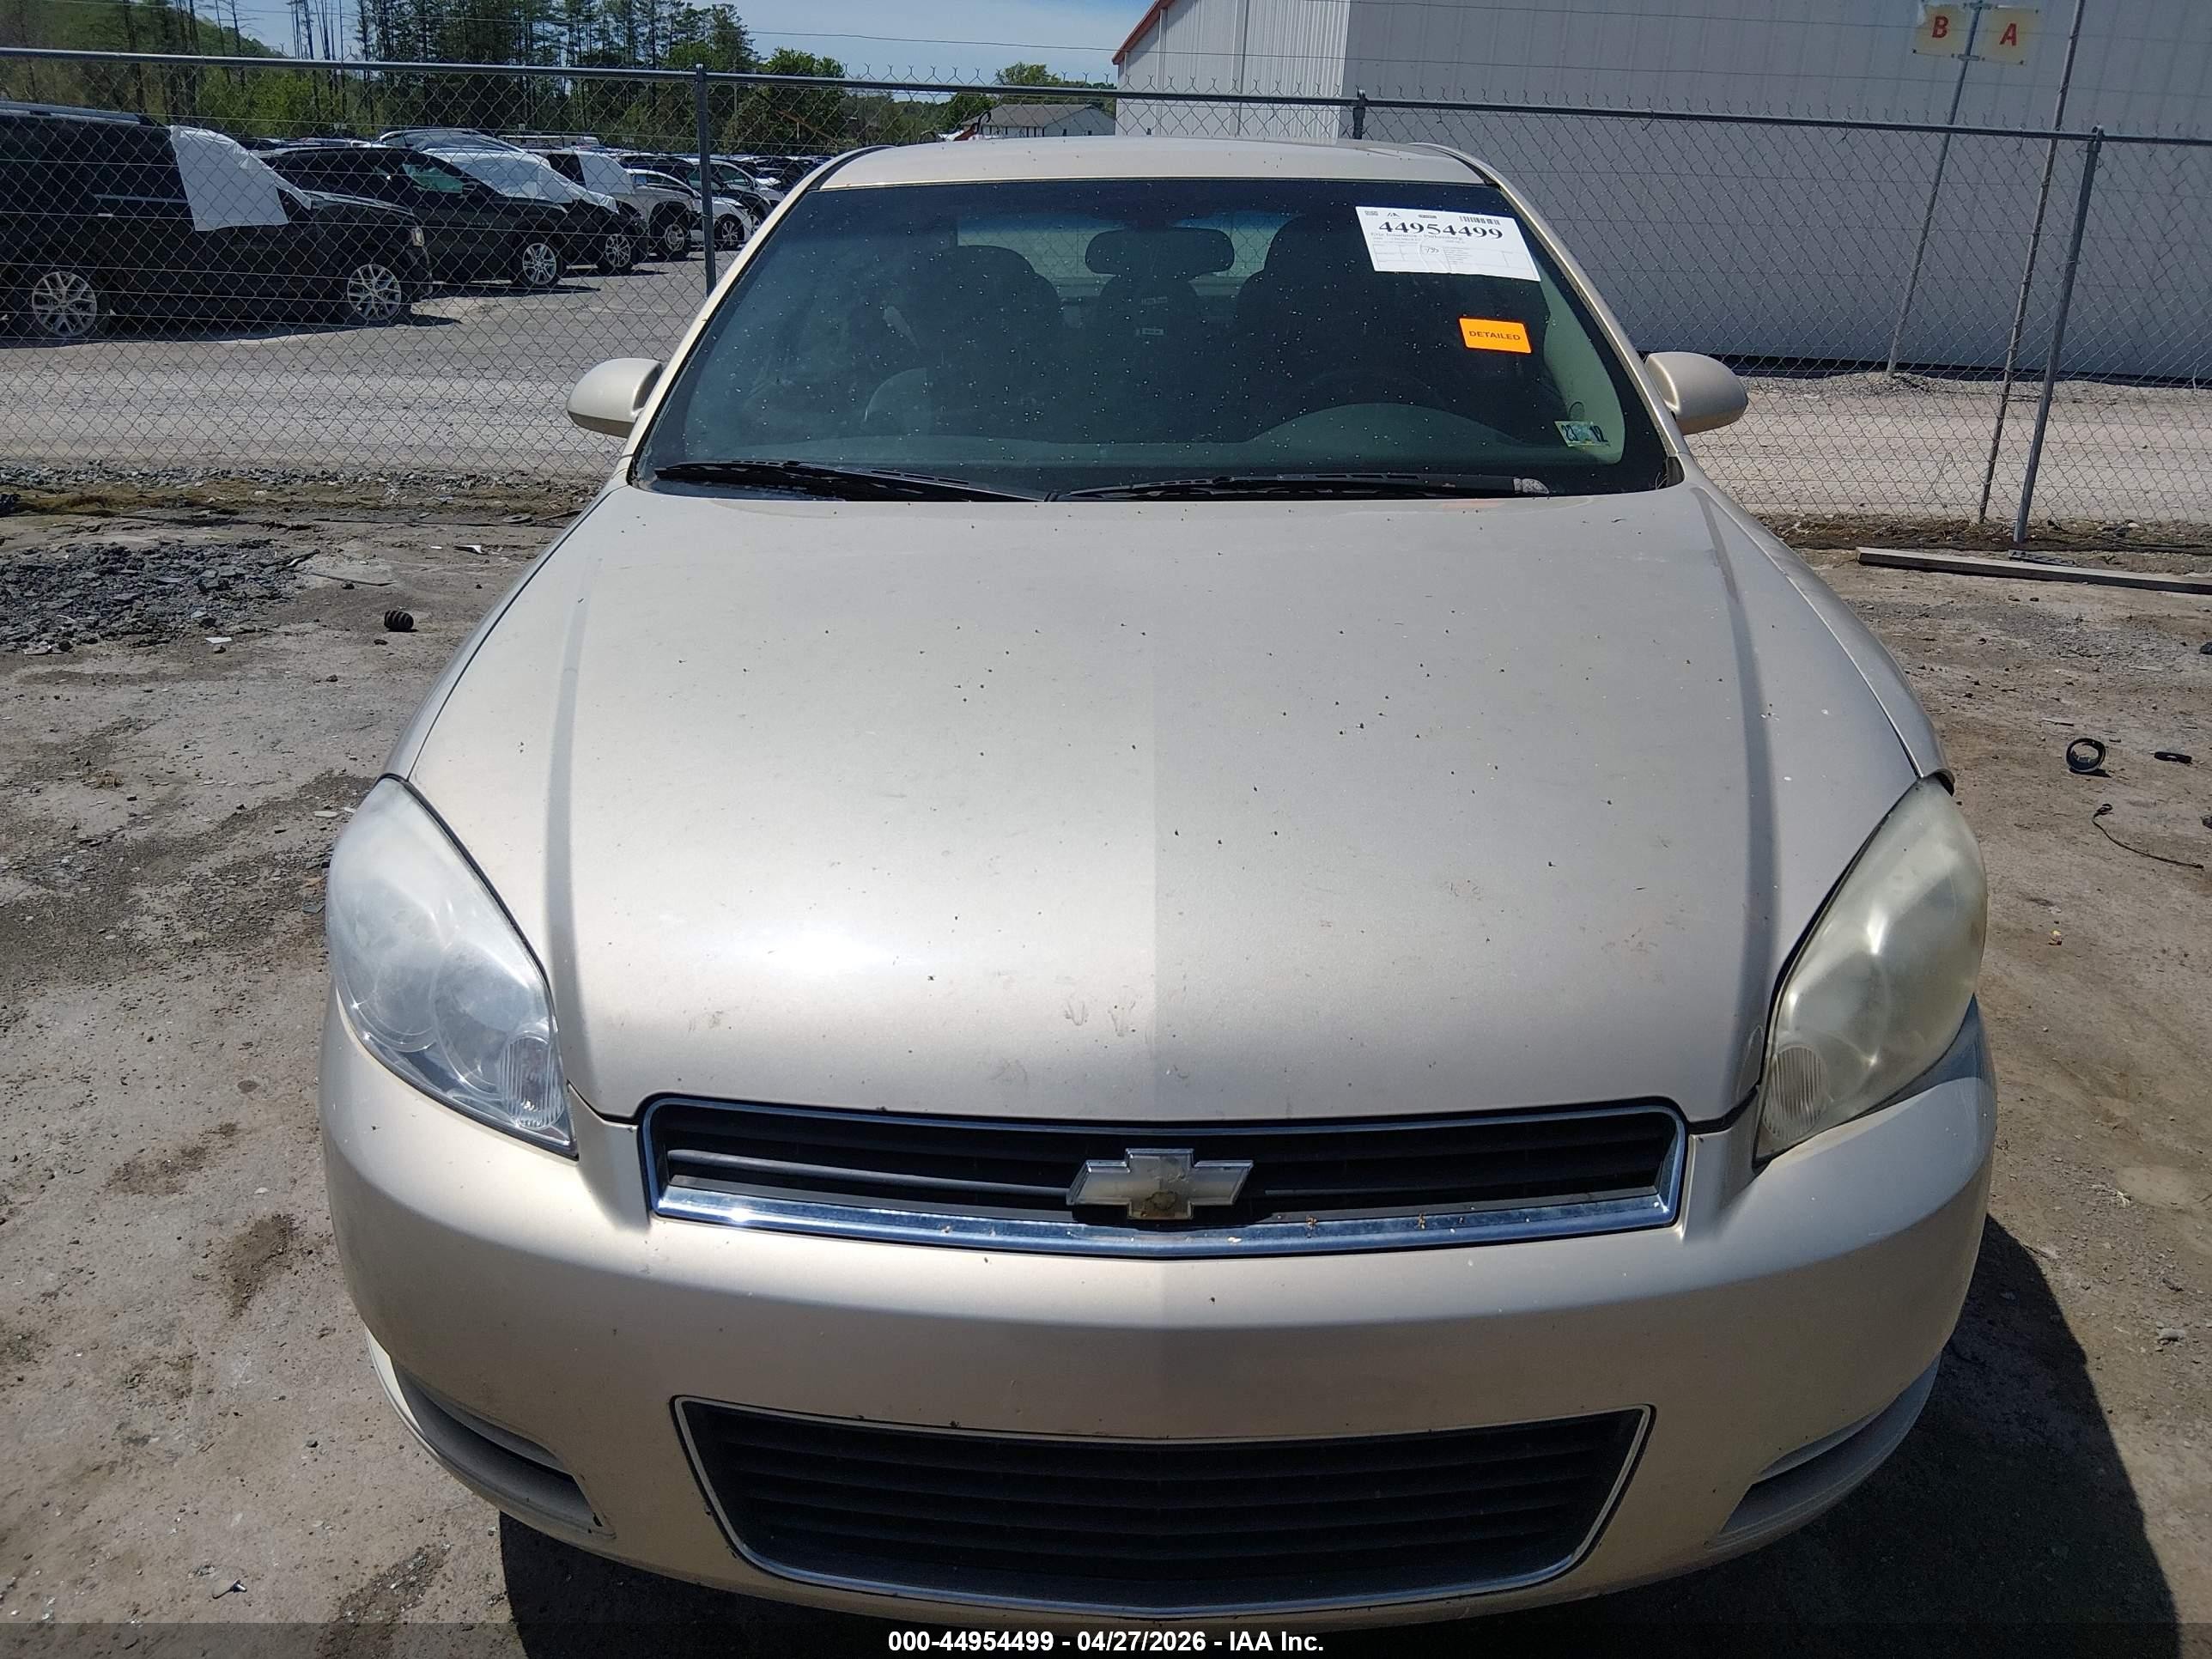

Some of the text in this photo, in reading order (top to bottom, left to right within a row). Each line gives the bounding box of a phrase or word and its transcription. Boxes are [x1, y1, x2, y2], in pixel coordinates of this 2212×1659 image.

[1931, 15, 1949, 39] B
[1998, 22, 2018, 46] A
[1378, 222, 1503, 240] 44954499
[1468, 331, 1521, 341] DETAILED
